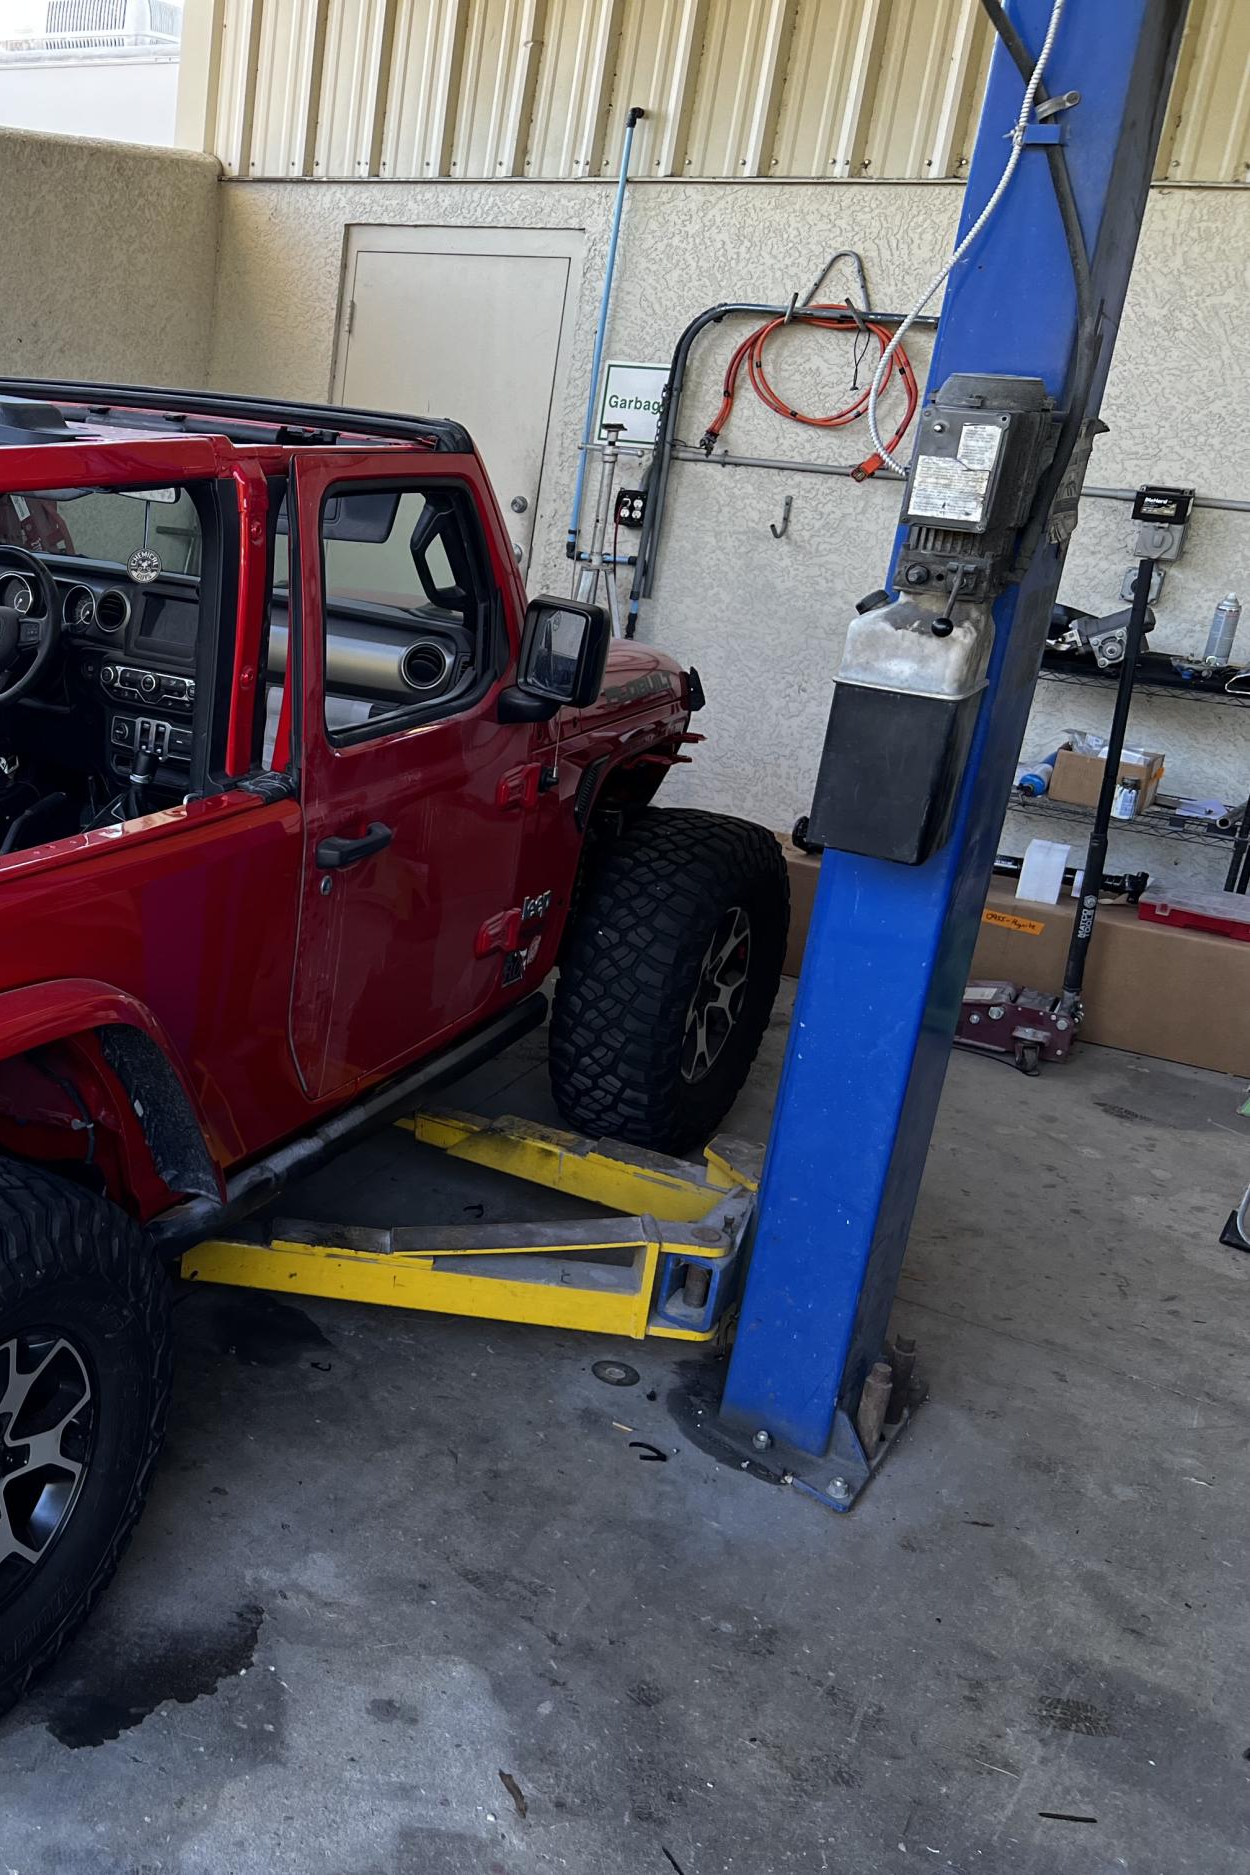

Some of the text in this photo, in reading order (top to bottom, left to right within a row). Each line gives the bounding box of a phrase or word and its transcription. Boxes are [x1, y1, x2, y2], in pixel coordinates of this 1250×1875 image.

[608, 395, 663, 415] Garbag
[130, 551, 159, 567] CHEMICAL
[522, 889, 552, 920] Jeep
[1077, 908, 1089, 939] MATCO
[1085, 909, 1095, 937] TOOLS
